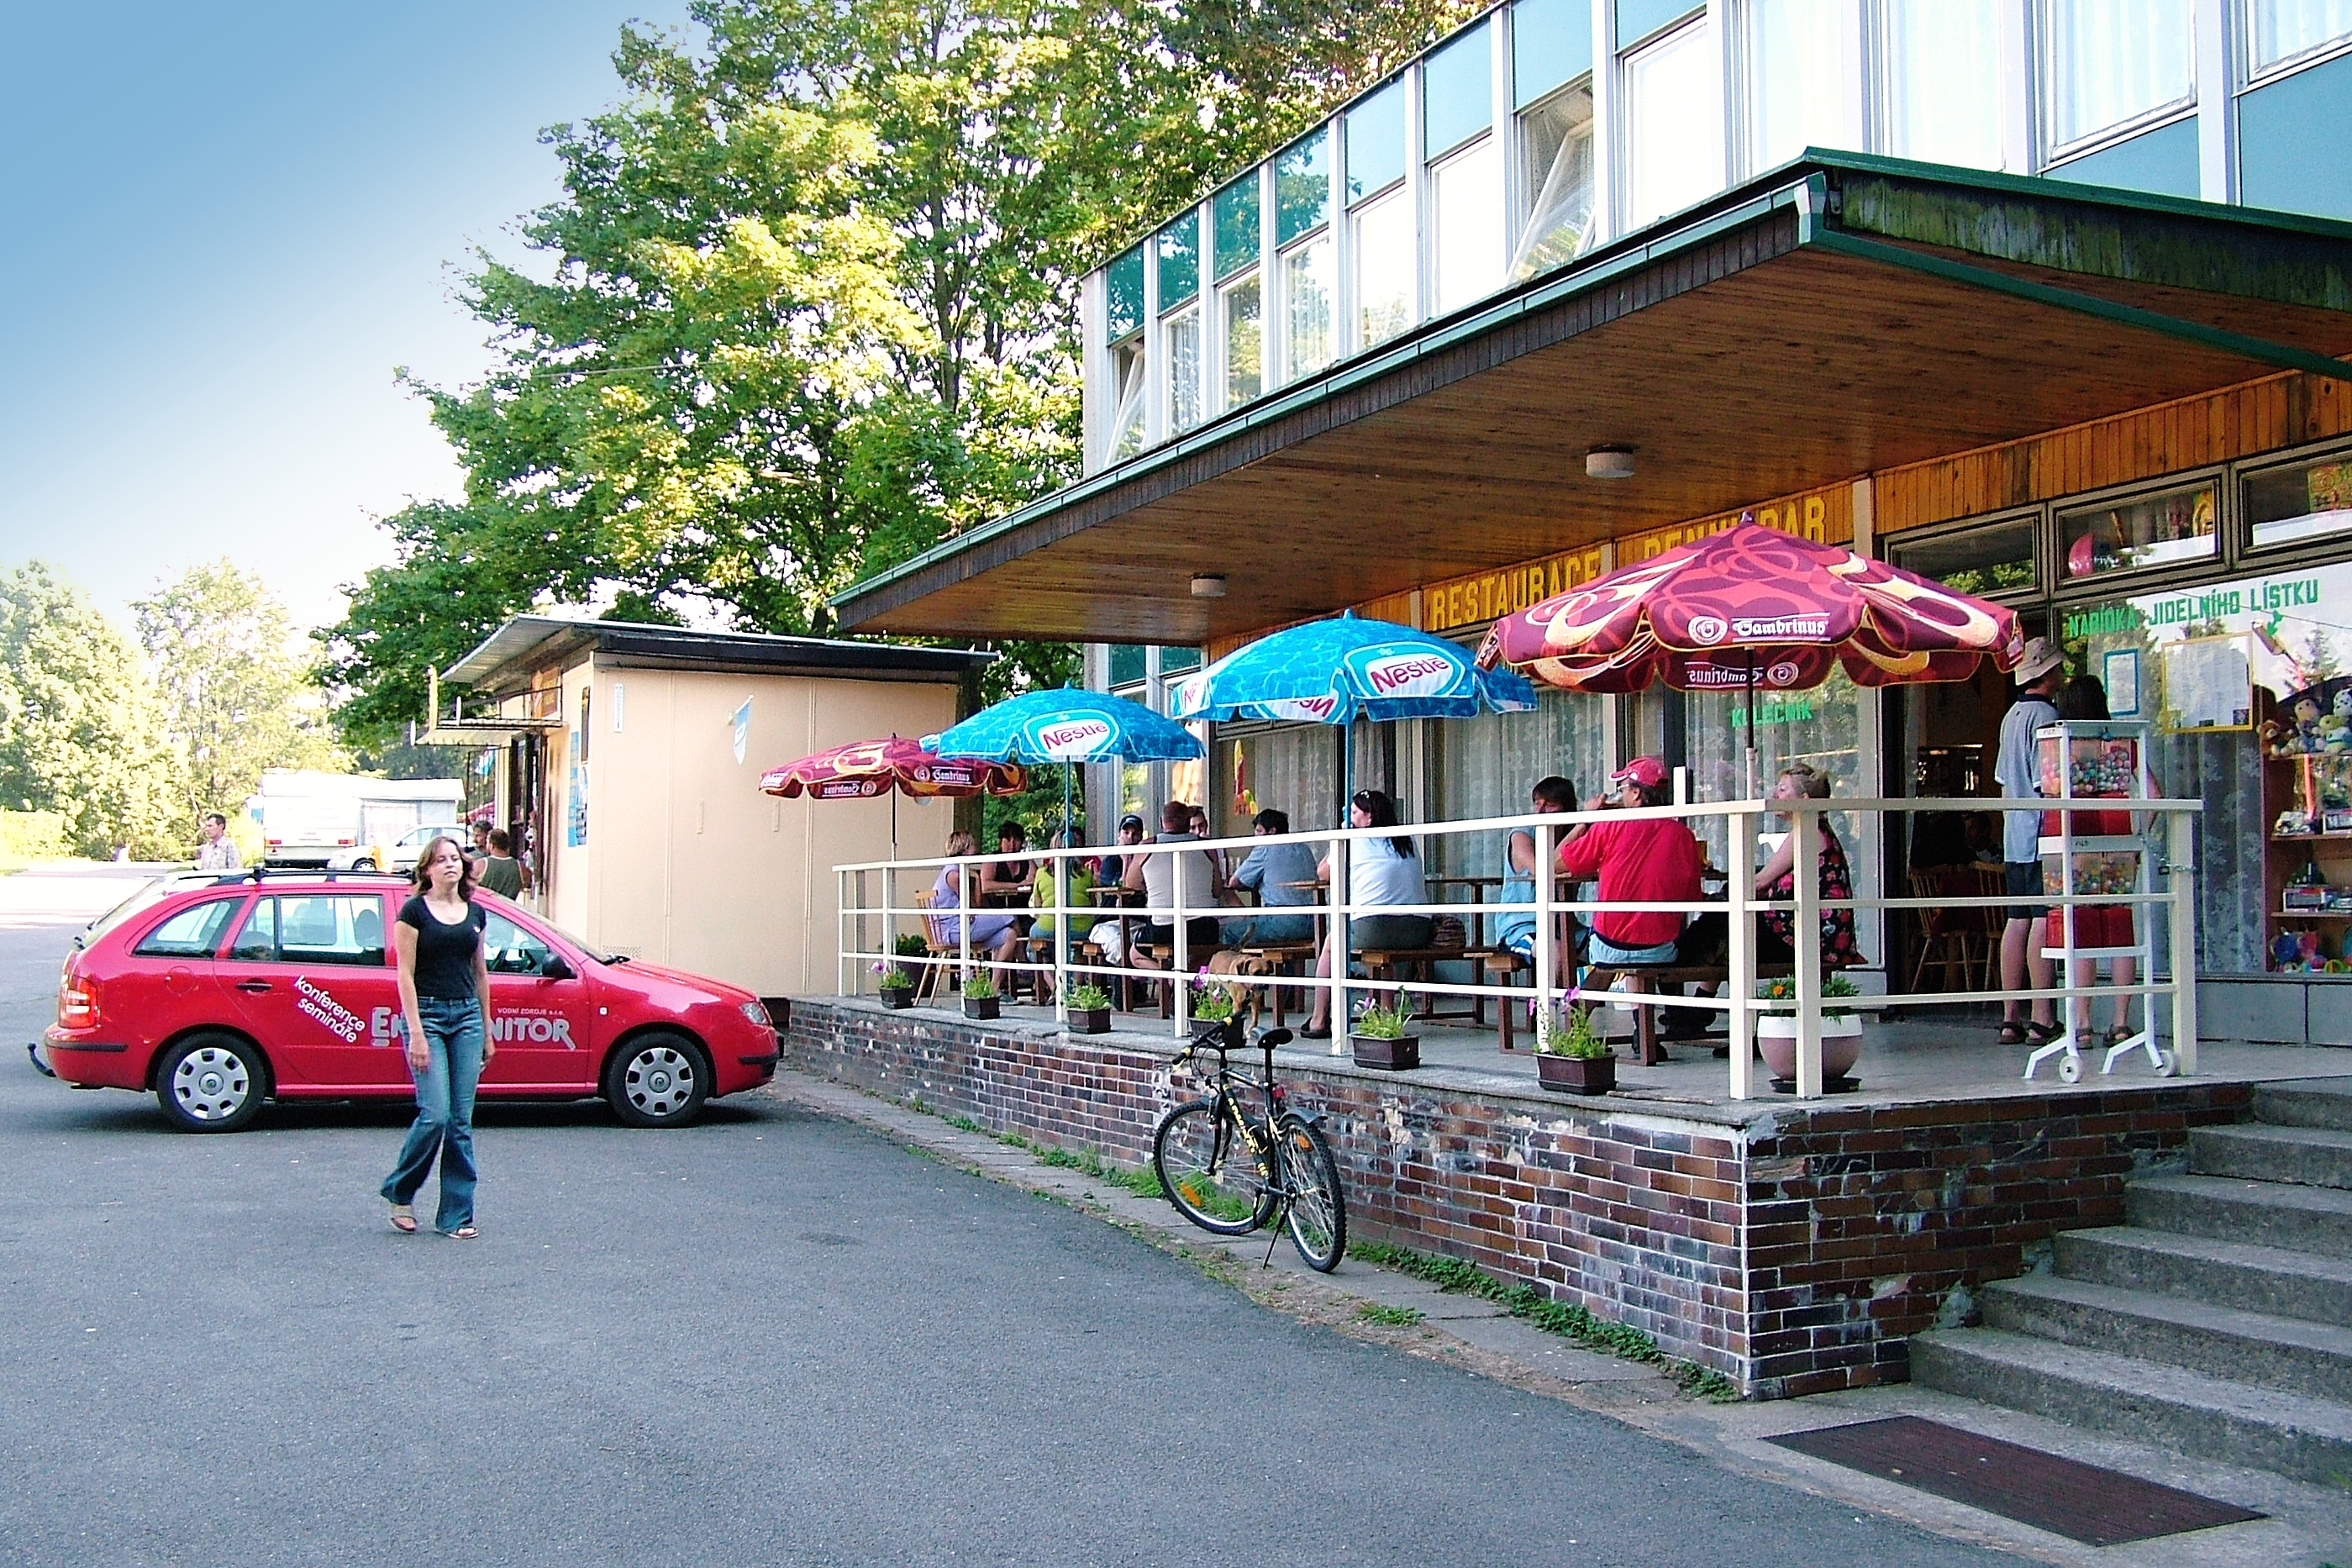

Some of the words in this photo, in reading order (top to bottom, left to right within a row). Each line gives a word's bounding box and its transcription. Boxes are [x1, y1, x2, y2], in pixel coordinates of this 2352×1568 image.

[1432, 551, 1602, 631] RESTAURACE
[2250, 578, 2318, 612] LÍSTKU
[1732, 618, 1828, 637] Gambrinus
[294, 975, 366, 1031] konference
[297, 998, 357, 1043] semináře
